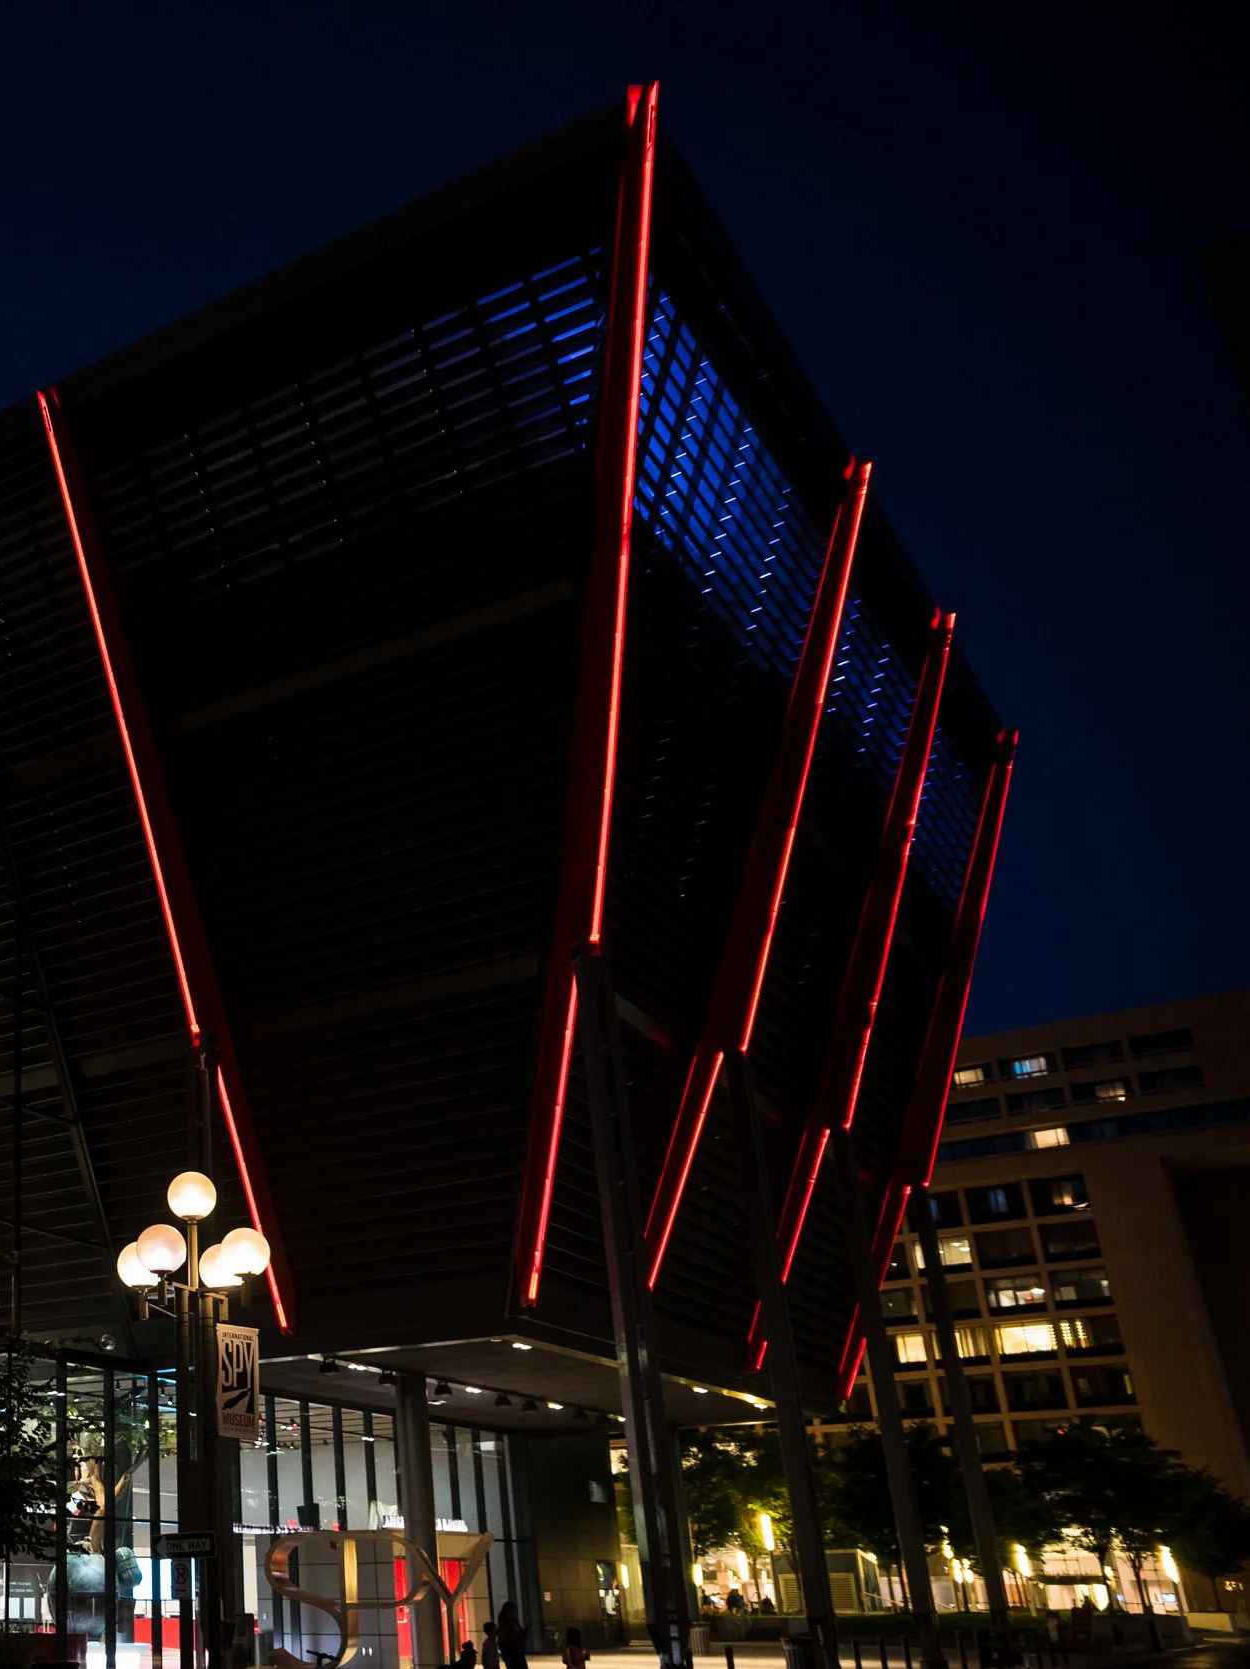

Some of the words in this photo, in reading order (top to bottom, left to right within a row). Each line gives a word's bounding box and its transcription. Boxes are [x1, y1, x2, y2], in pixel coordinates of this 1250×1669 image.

[221, 1331, 255, 1342] INTERNATIONAL
[221, 1339, 254, 1389] SPY
[222, 1411, 255, 1428] MUSEUM
[166, 1541, 186, 1551] ONE
[188, 1539, 207, 1550] WAY
